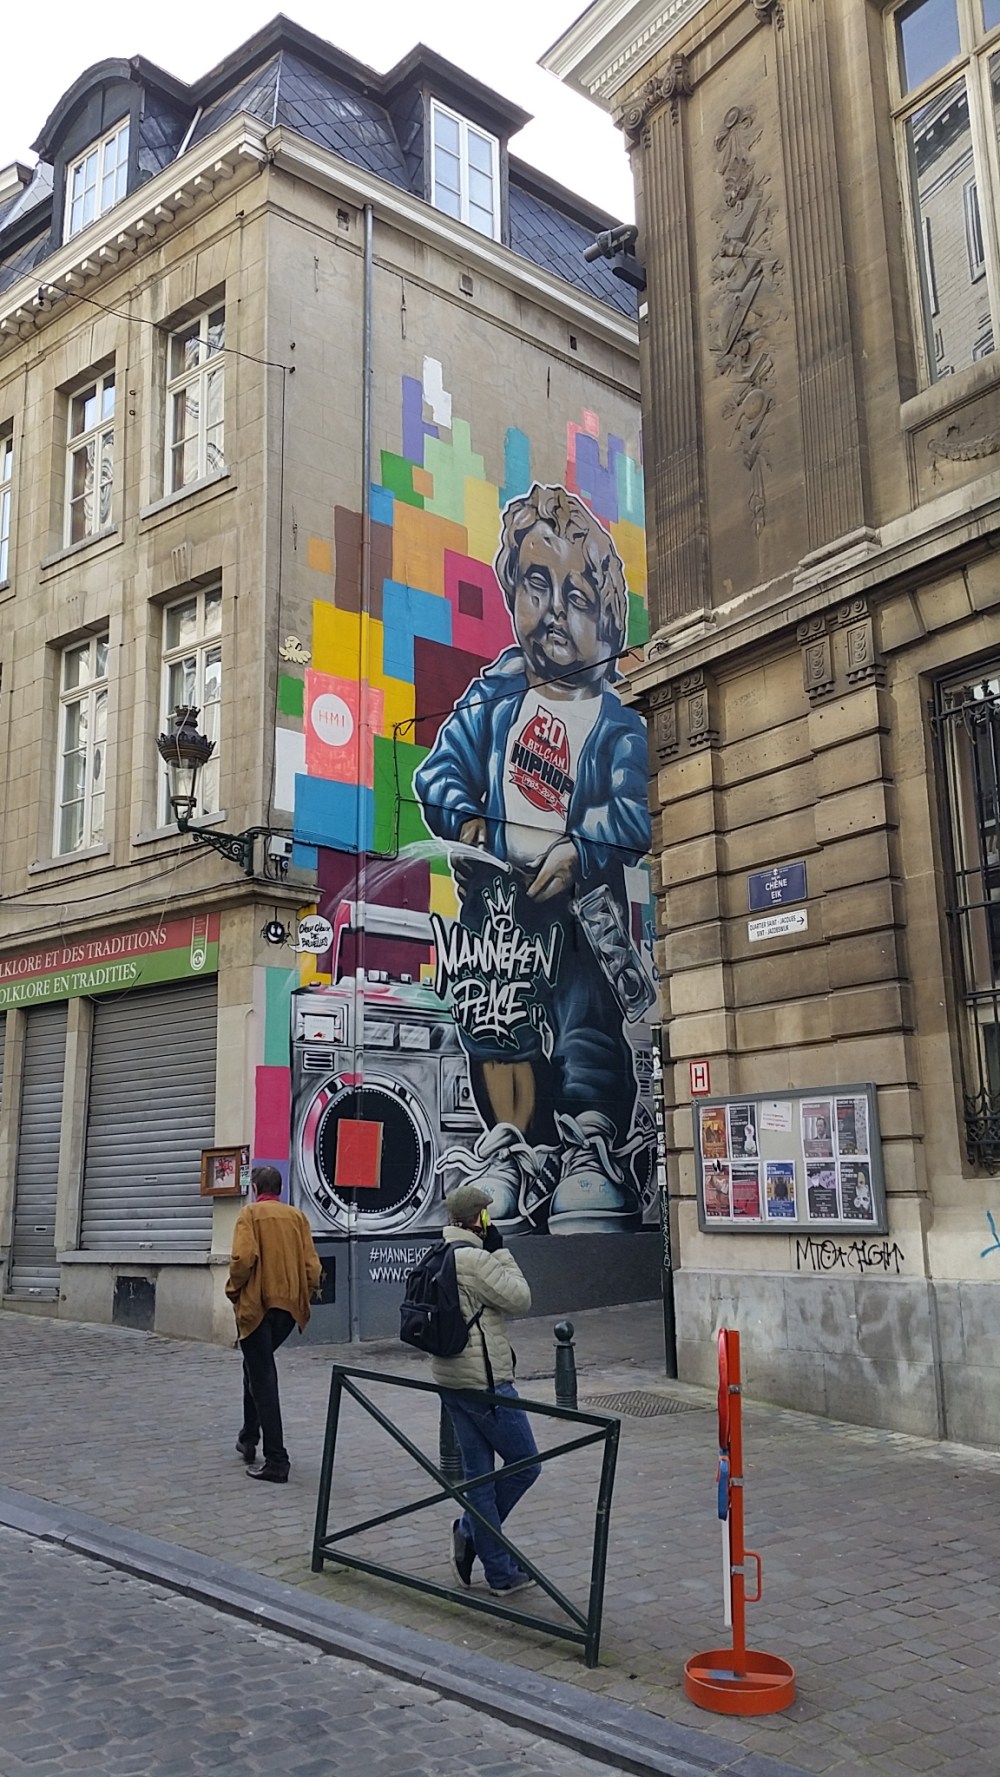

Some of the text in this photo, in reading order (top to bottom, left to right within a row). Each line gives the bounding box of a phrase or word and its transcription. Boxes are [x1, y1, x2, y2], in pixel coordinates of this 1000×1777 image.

[318, 709, 345, 728] HMI
[533, 704, 567, 751] 30
[771, 889, 782, 900] EIK
[45, 950, 59, 968] ET
[62, 945, 85, 965] DES
[86, 927, 167, 959] TRADITIONS
[431, 914, 559, 995] MANNEKEN
[53, 975, 70, 994] EN
[71, 962, 137, 990] TRADITIES
[694, 1066, 705, 1088] H
[369, 1266, 413, 1282] WWW.C
